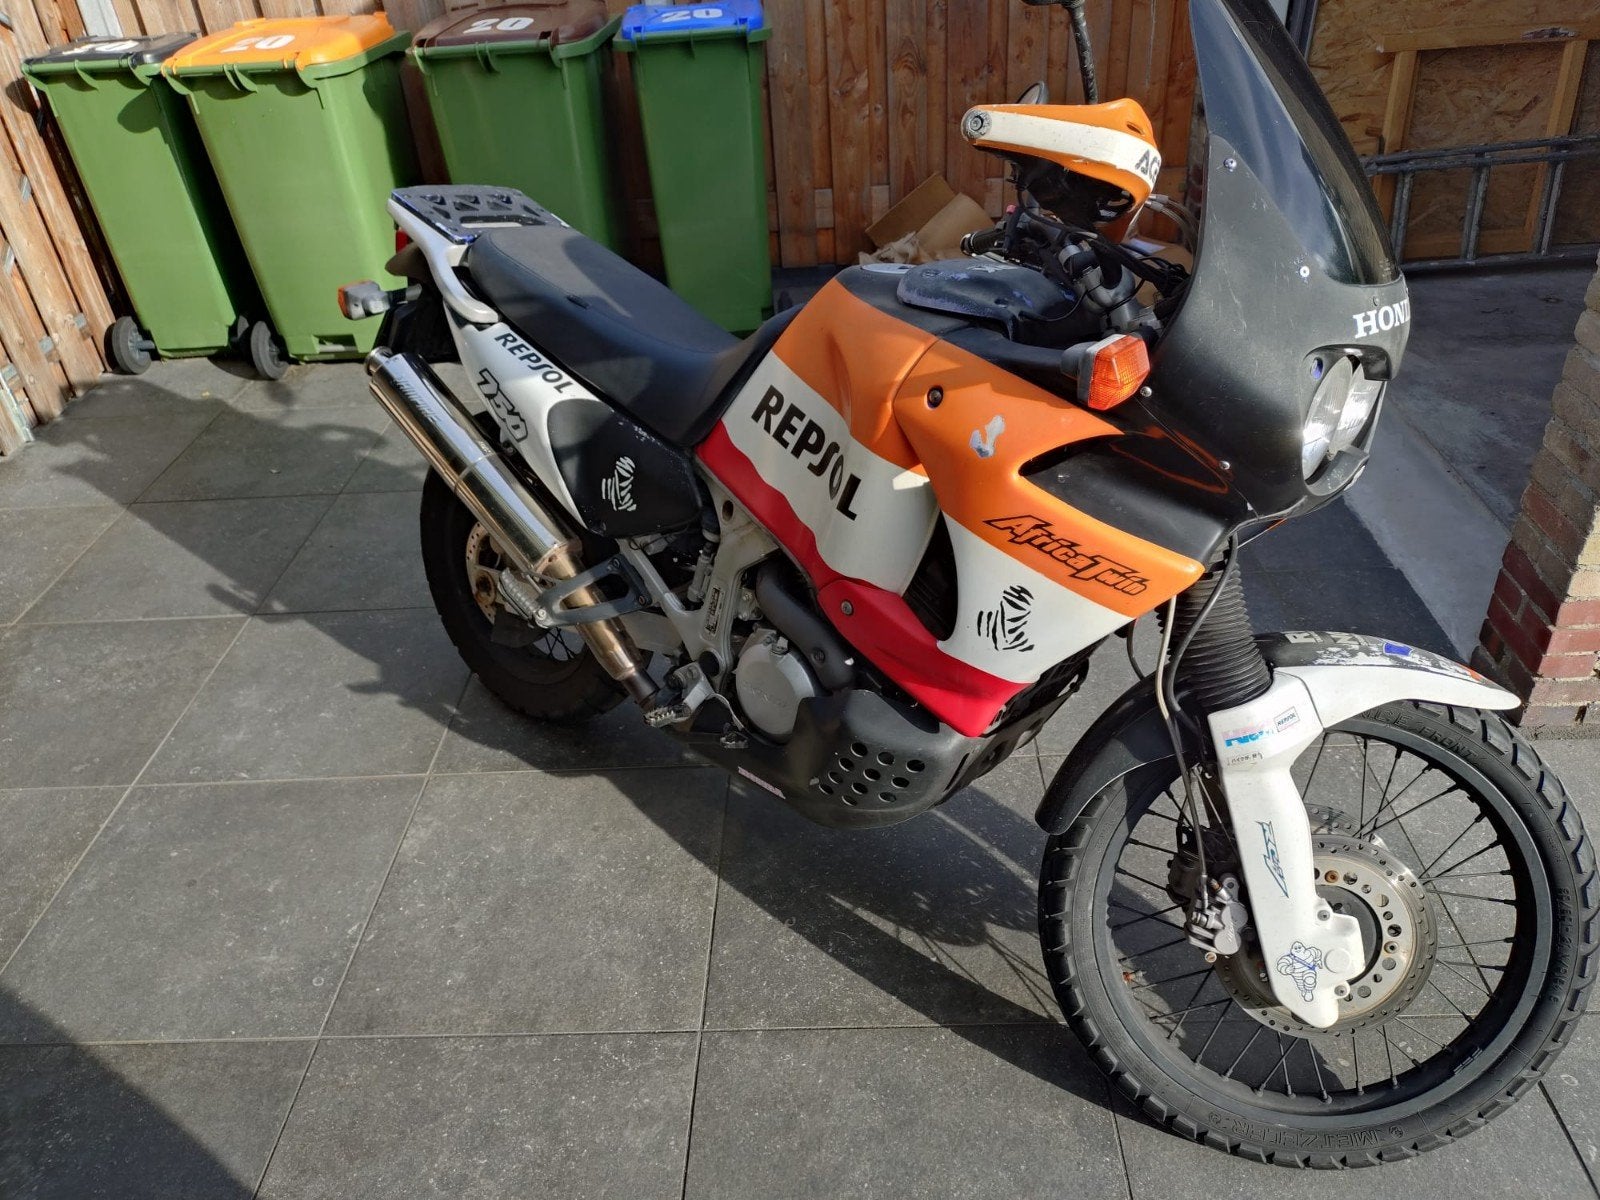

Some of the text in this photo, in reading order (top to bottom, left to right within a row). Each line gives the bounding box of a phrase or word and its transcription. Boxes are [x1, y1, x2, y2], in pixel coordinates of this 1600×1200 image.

[463, 17, 534, 34] 20
[661, 8, 723, 22] 20
[220, 34, 295, 53] 20
[494, 332, 574, 394] REPSOL
[477, 366, 528, 443] 750
[751, 384, 862, 521] REPSOL
